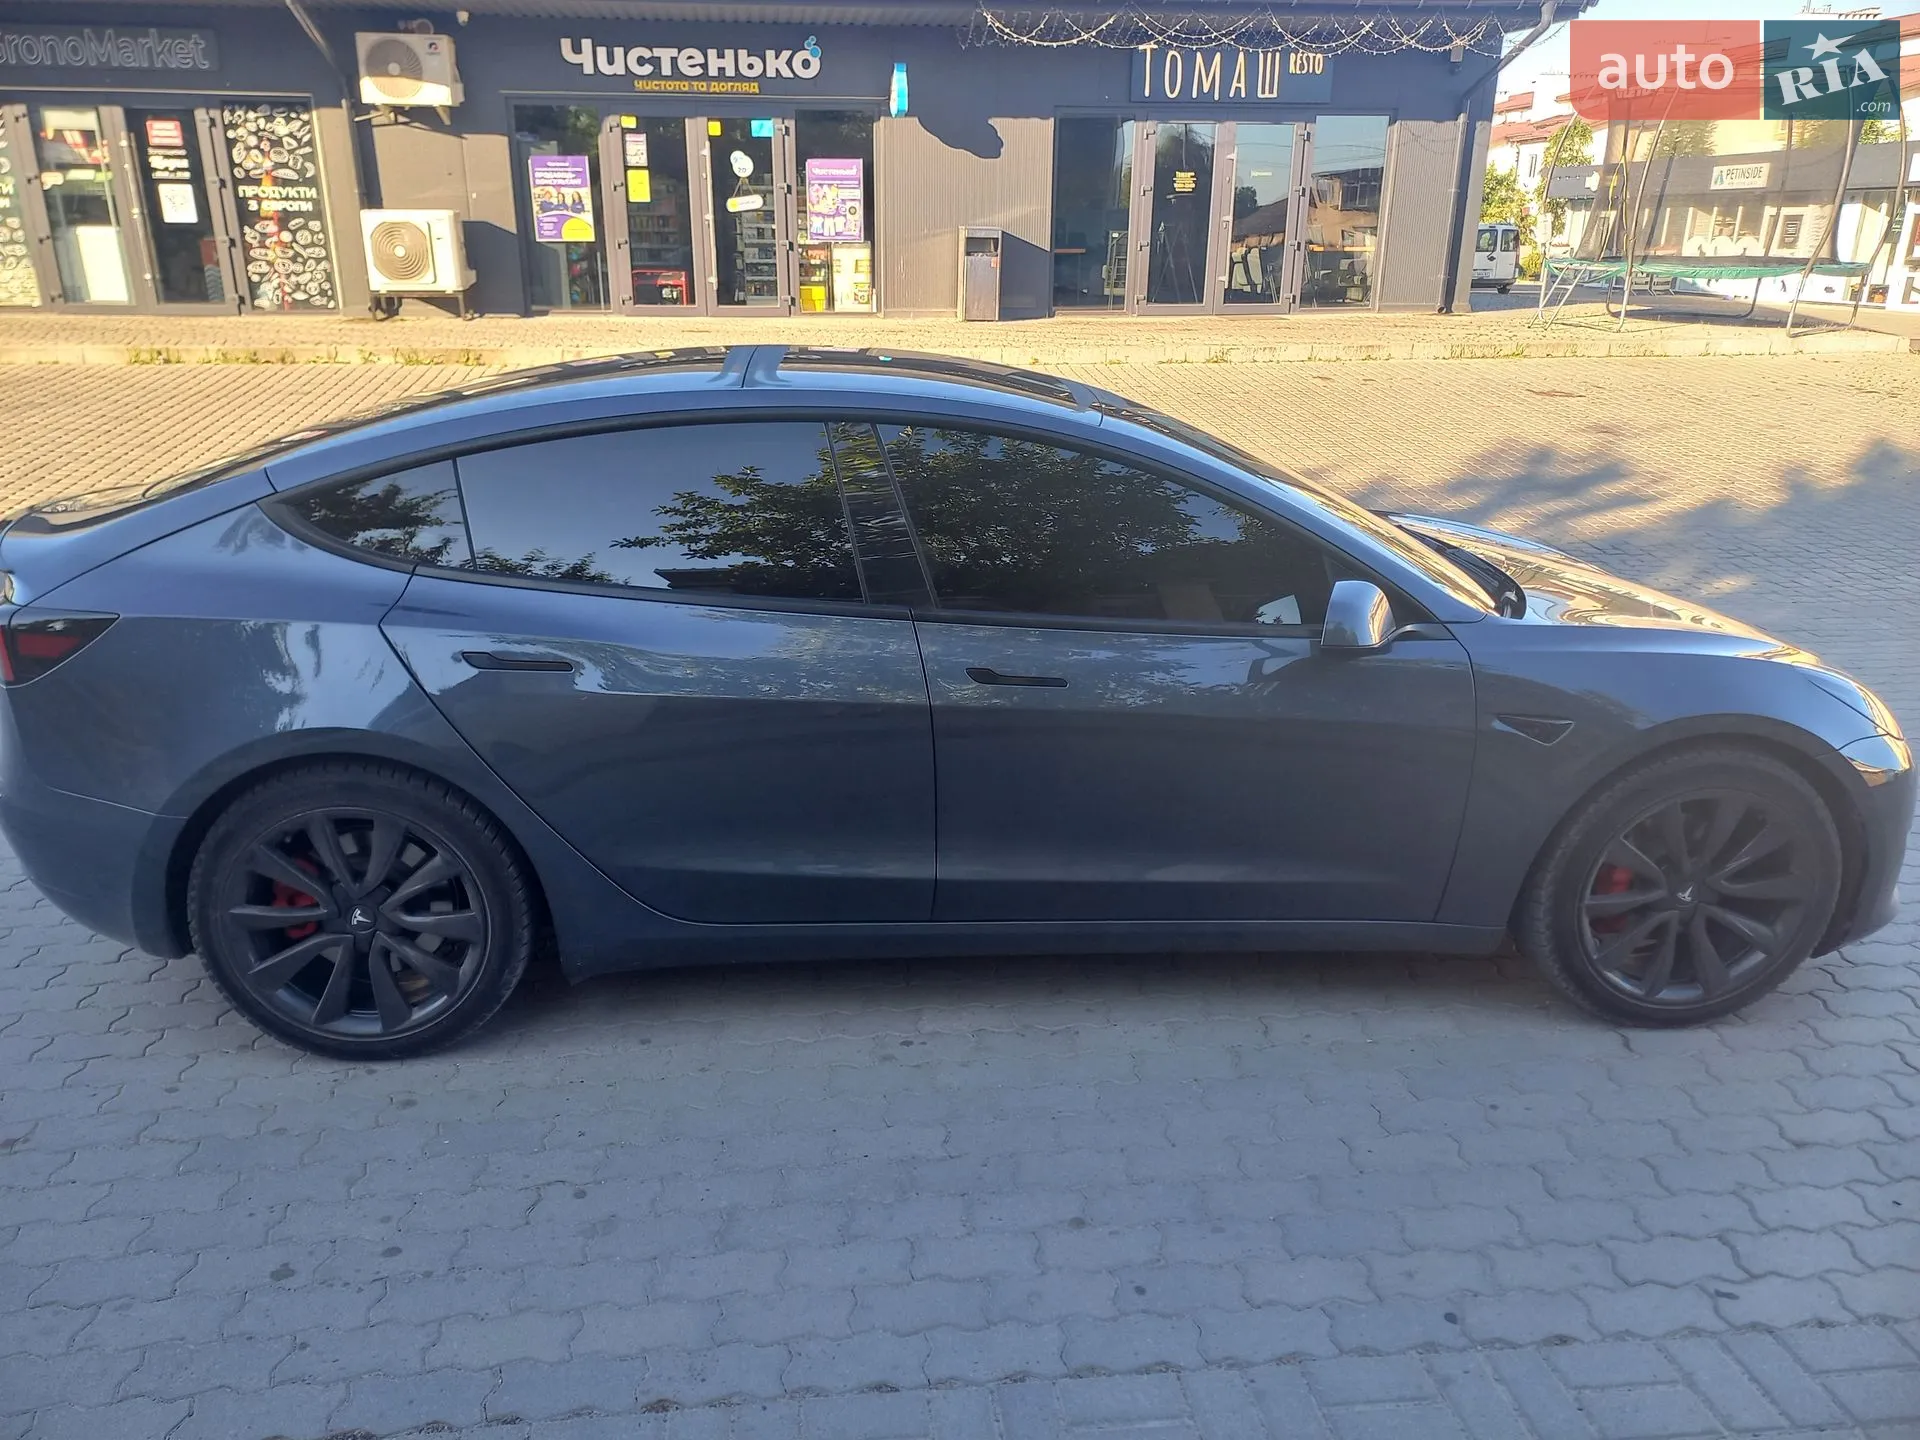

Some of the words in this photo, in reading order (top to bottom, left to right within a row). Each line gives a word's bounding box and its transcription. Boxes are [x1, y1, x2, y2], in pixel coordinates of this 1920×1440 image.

[559, 36, 822, 80] Чистенько
[633, 79, 690, 92] чистота
[691, 80, 707, 92] та
[709, 81, 760, 95] догляд
[237, 184, 318, 199] ПРОДУКТИ
